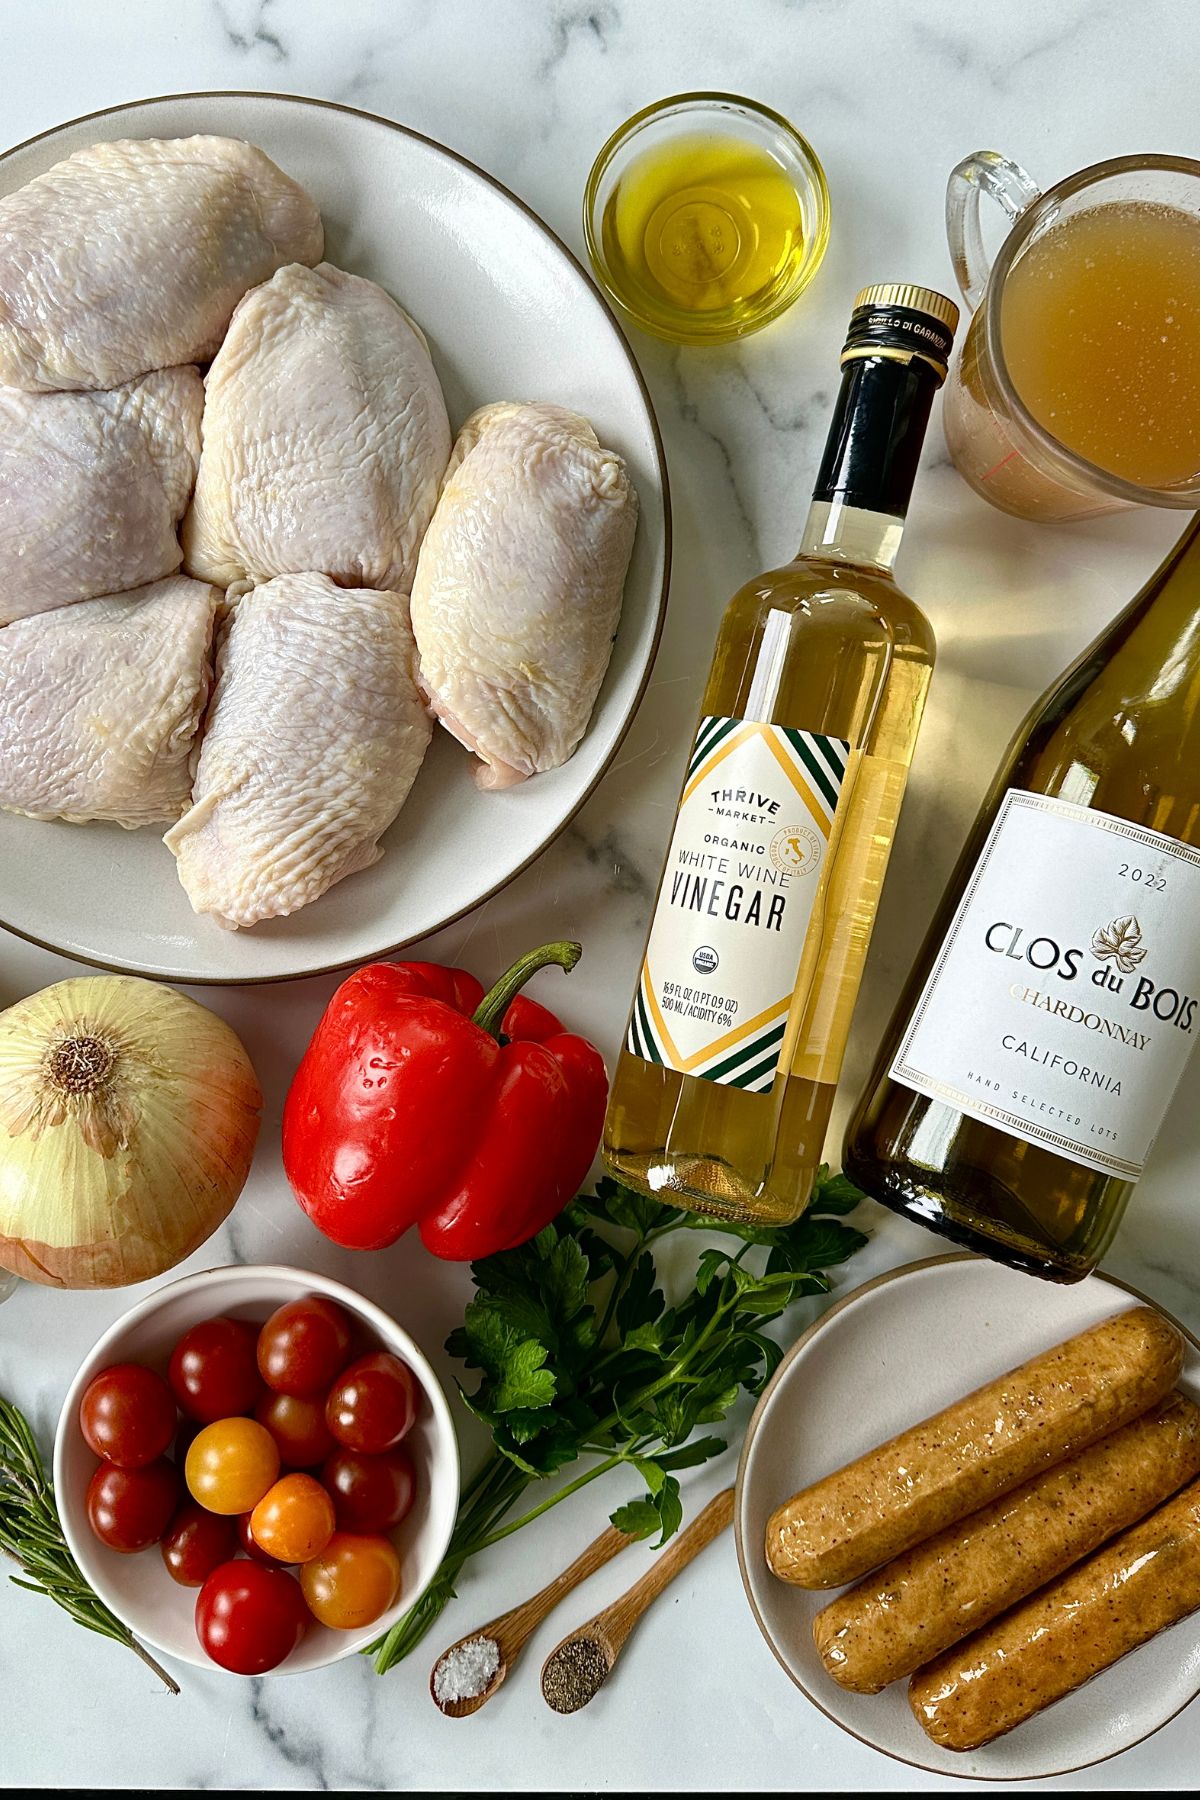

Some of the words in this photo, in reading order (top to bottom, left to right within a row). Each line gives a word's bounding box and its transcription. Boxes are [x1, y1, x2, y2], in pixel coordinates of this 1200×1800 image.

[902, 322, 913, 331] DI
[913, 324, 947, 350] GARANZIA
[711, 789, 781, 815] THRIVE
[704, 834, 765, 855] ORGANIC
[678, 849, 730, 873] WHITE
[738, 862, 793, 888] WINE
[1118, 863, 1167, 892] 2022
[670, 870, 786, 932] VINEGAR
[985, 922, 1084, 981] CLOS
[1091, 964, 1124, 994] du
[661, 996, 674, 1010] 500
[717, 1012, 732, 1027] 6%
[674, 985, 681, 998] FL
[683, 988, 693, 1001] OZ
[693, 990, 700, 1004] (1
[700, 992, 712, 1006] PT
[711, 995, 724, 1009] 0.9
[724, 999, 739, 1014] OZ)
[1010, 983, 1152, 1052] CHARDONNAY
[1002, 1035, 1122, 1096] CALIFORNIA
[967, 1071, 1001, 1091] HAND
[1012, 1091, 1081, 1126] SELECTED
[1090, 1124, 1119, 1141] LOTS
